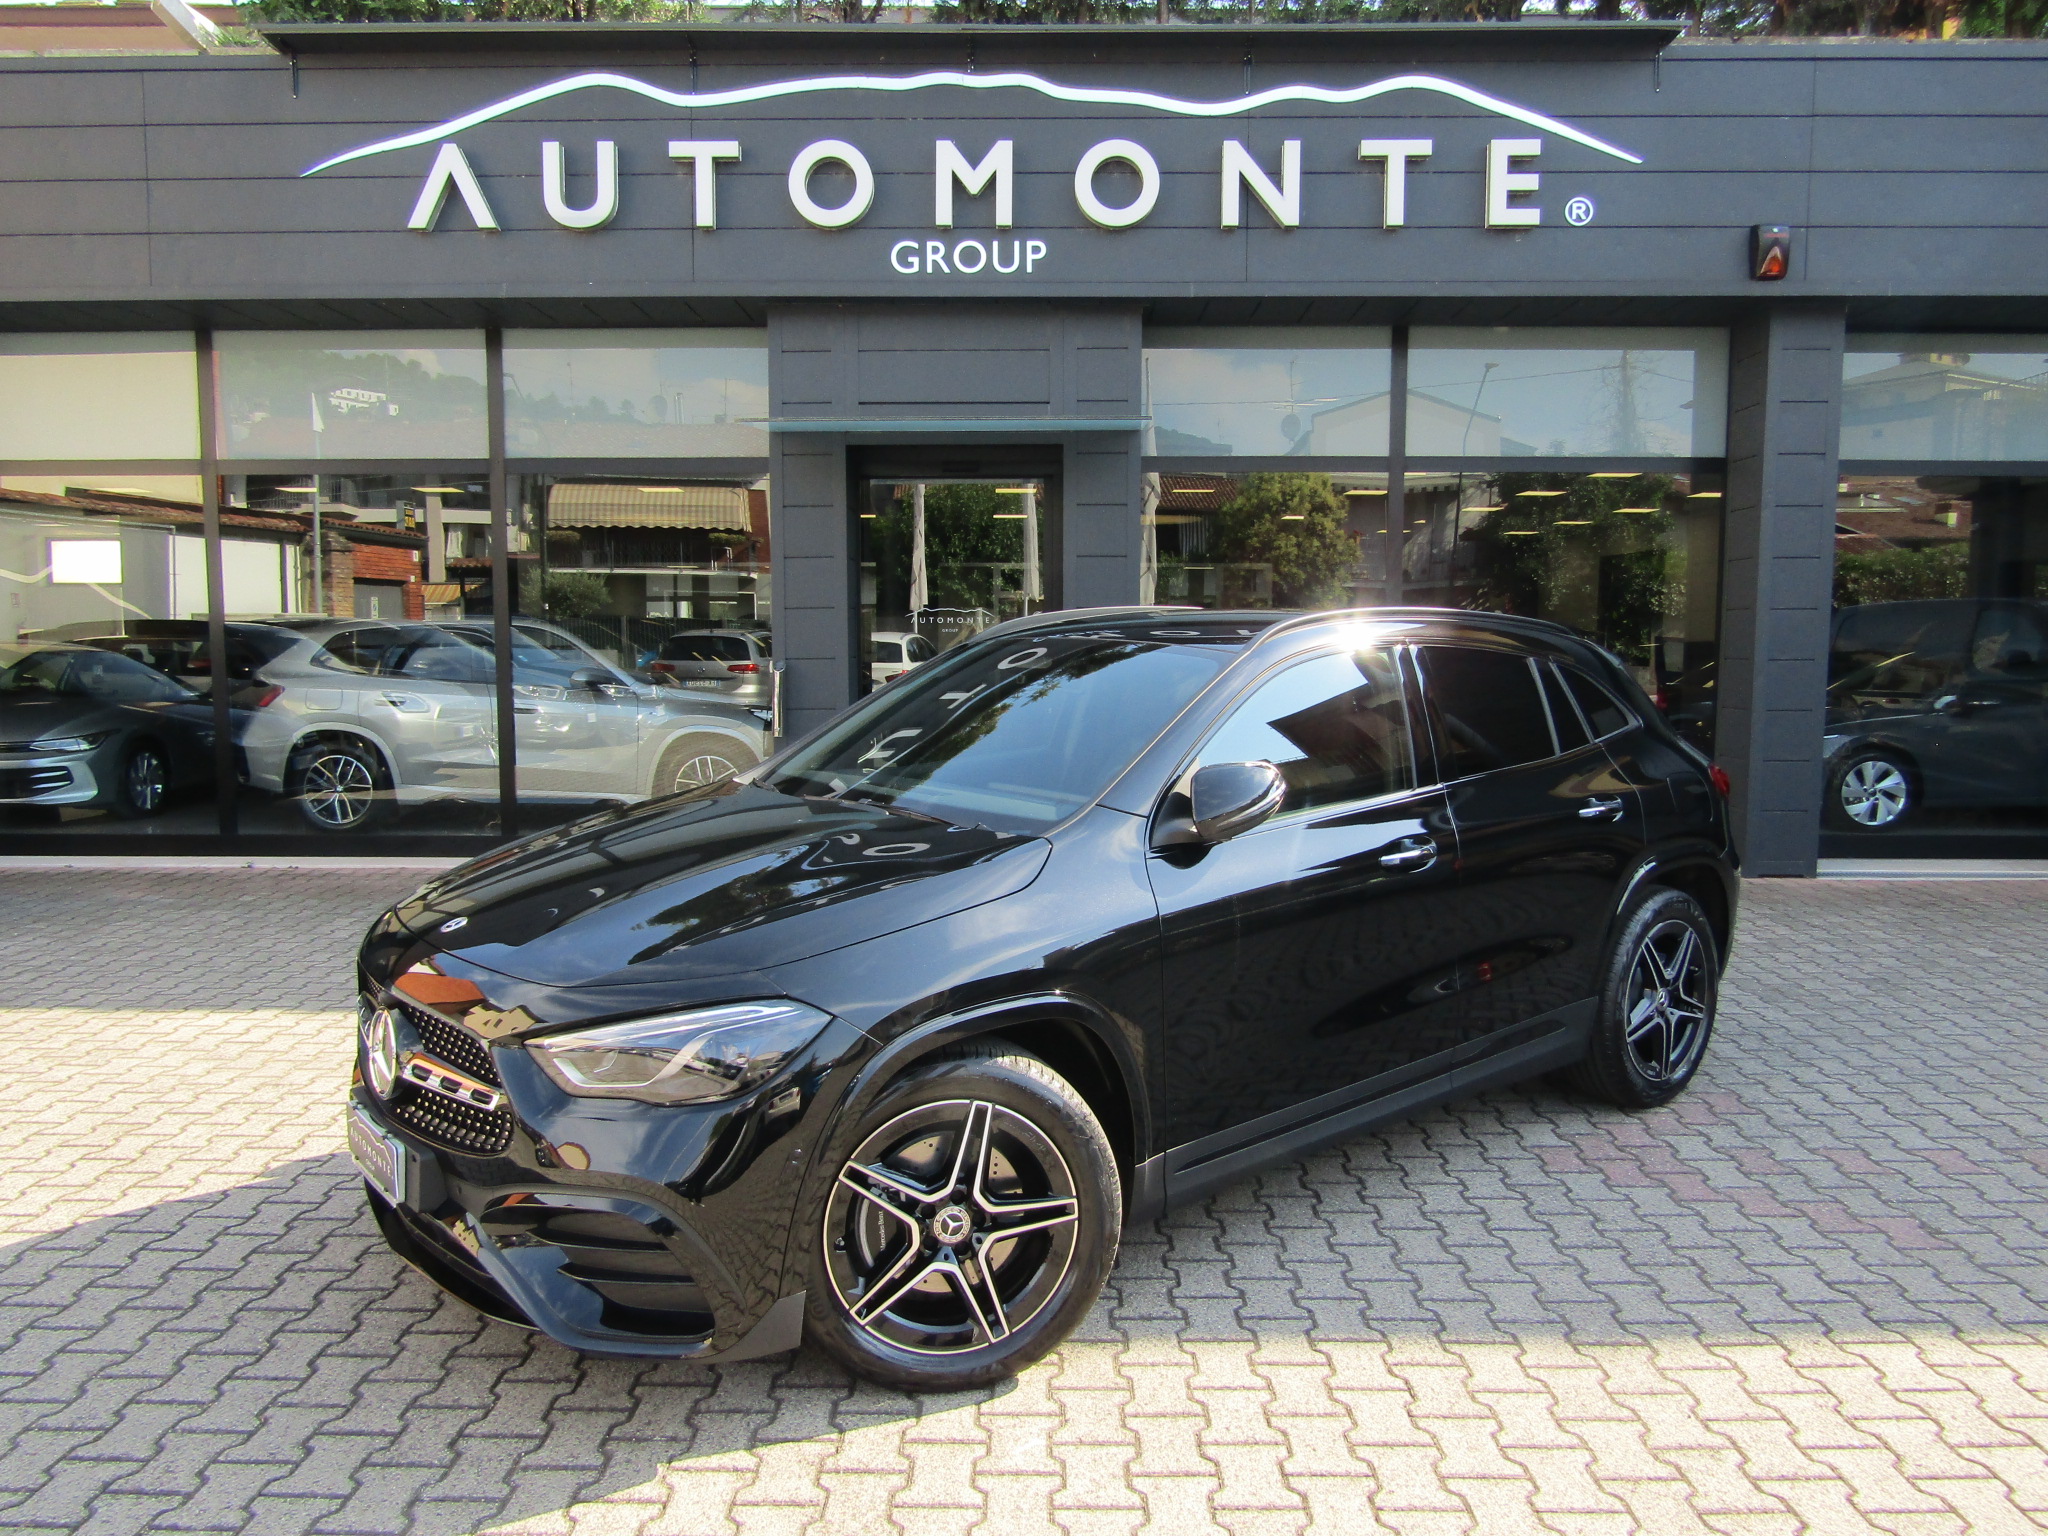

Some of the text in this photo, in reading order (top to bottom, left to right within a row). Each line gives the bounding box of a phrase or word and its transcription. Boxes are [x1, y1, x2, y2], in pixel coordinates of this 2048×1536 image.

[406, 138, 1543, 231] AUTOMONTE
[890, 240, 1048, 274] GROUP
[911, 616, 991, 625] AUTOMONTE
